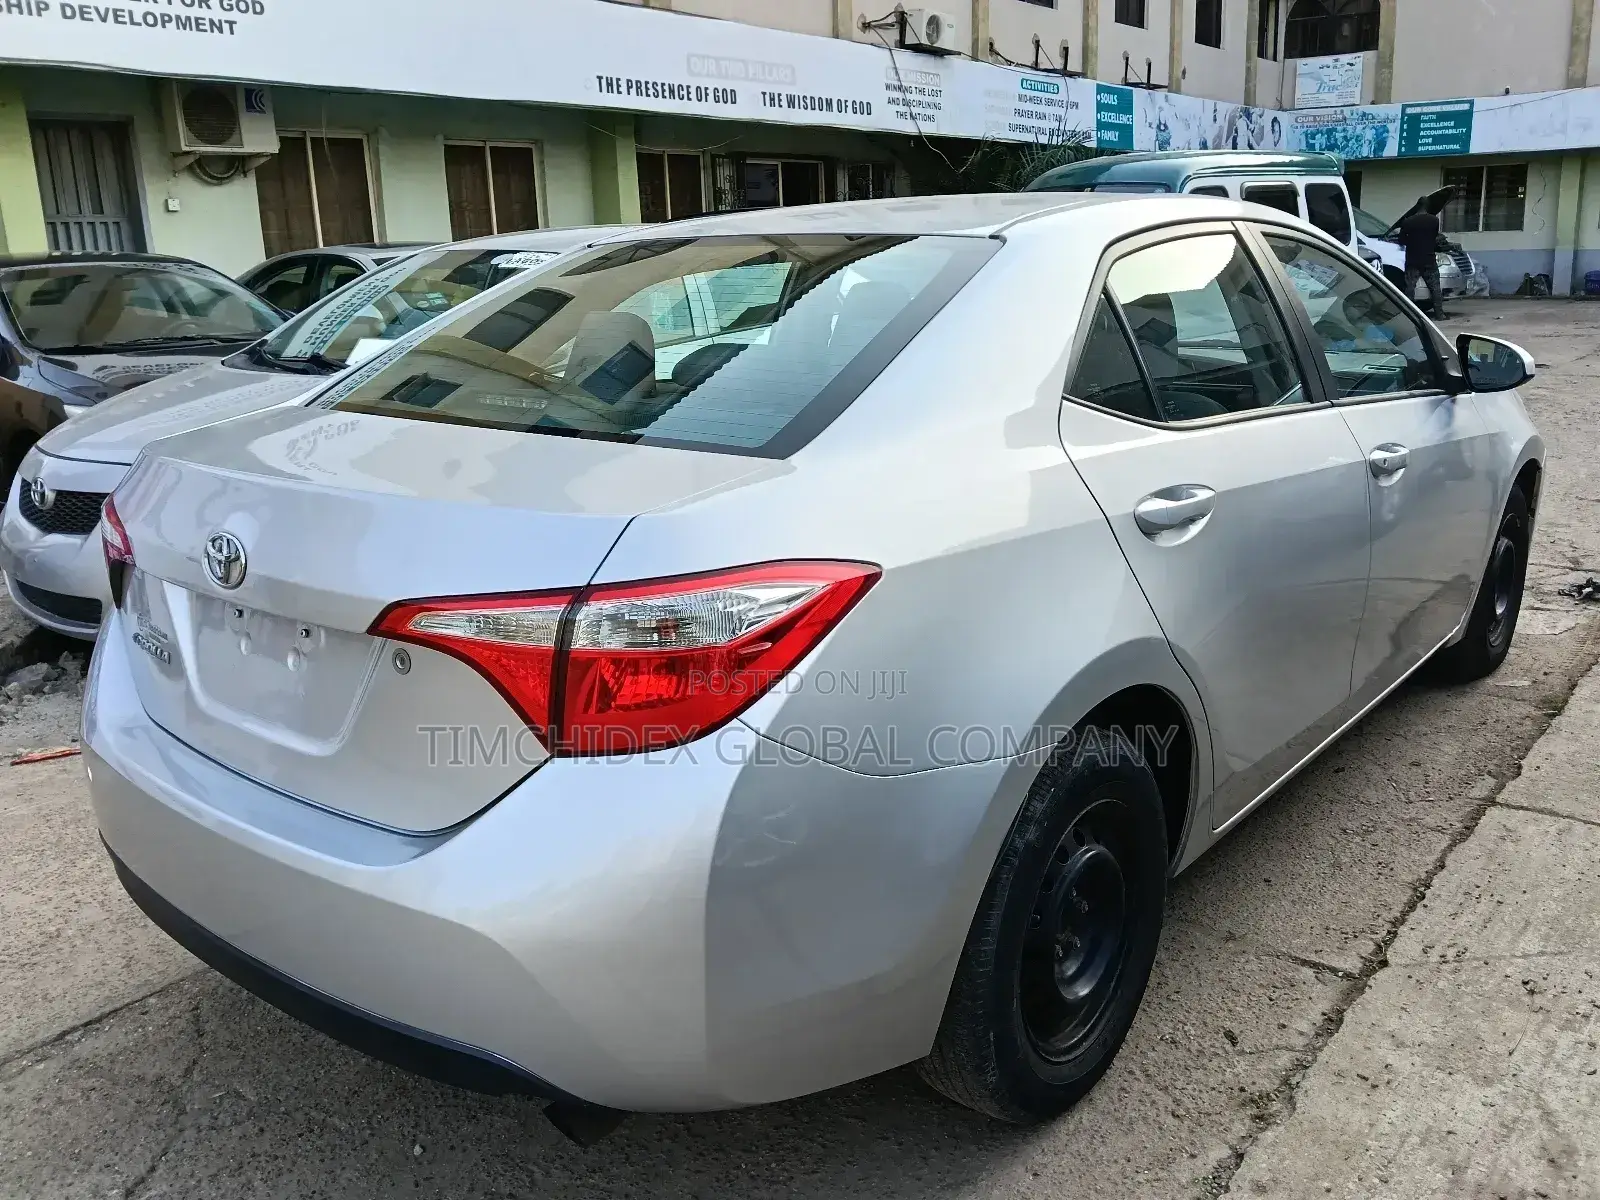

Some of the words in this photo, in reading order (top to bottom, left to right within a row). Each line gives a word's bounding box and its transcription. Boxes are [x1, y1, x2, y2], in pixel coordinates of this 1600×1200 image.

[219, 0, 265, 15] GOD
[0, 0, 50, 17] HIP
[60, 2, 238, 35] DEVELOPMENT
[596, 75, 622, 95] THE
[626, 79, 692, 102] PRESENCE
[695, 85, 710, 103] OF
[713, 87, 737, 105] GOD
[885, 83, 912, 94] WINNING
[914, 86, 926, 96] THE
[928, 88, 942, 98] LOST
[1022, 79, 1058, 94] ACTIVITIES
[761, 91, 783, 108] THE
[786, 93, 834, 113] WISDOM
[837, 98, 849, 114] OF
[852, 100, 872, 116] GOD
[887, 97, 900, 106] AND
[902, 98, 942, 110] DISCIPLINING
[1018, 94, 1042, 105] MID-WEEK
[1044, 98, 1064, 108] SERVICE
[1100, 92, 1118, 105] SOULS
[896, 111, 908, 120] THE
[910, 112, 935, 122] NATIONS
[1014, 108, 1034, 119] PRAYER
[1035, 111, 1047, 121] RAIN
[1101, 112, 1133, 125] EXCELLENCE
[1008, 122, 1047, 136] SUPERNATURAL
[1420, 128, 1466, 136] ACCOUNTABILITY
[1101, 131, 1119, 142] FAMILY
